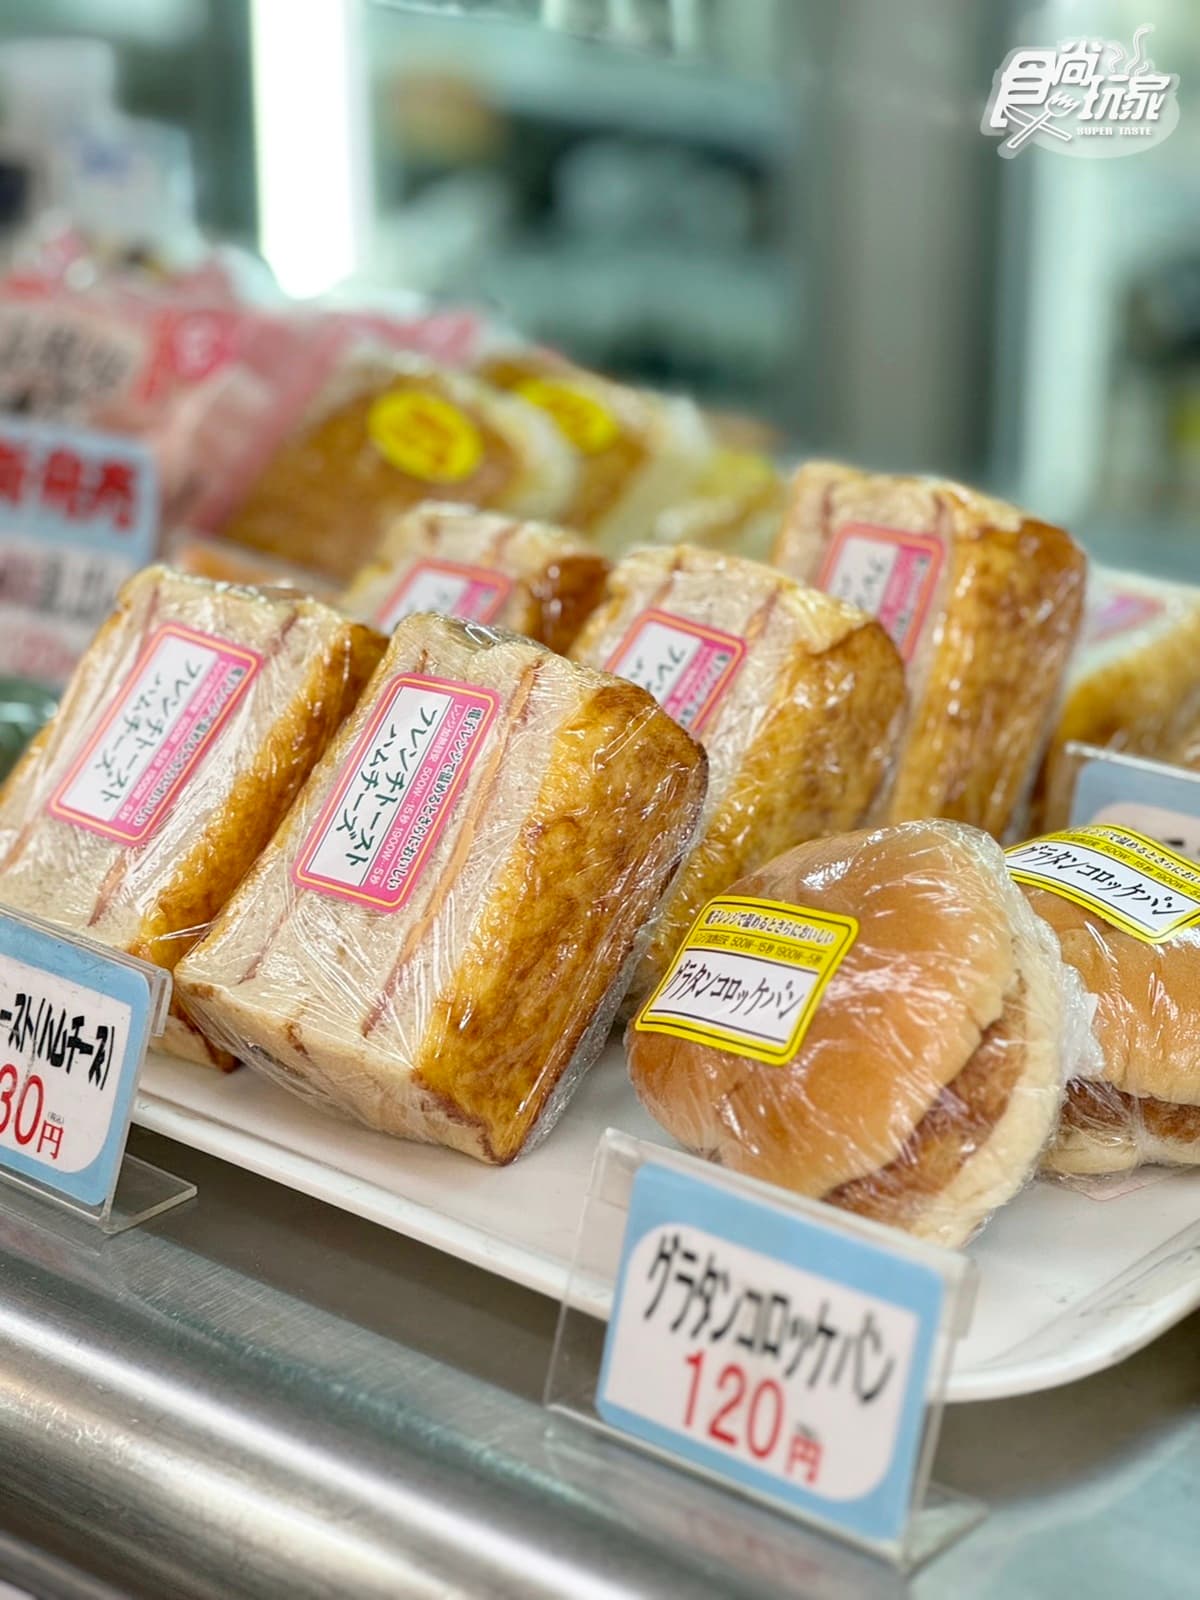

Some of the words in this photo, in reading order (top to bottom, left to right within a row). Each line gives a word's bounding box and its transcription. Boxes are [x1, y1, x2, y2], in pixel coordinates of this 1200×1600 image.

[95, 671, 161, 778] ハムチーズ
[100, 660, 202, 802] フレンチトースト
[335, 724, 397, 840] ハムチーズ
[345, 707, 438, 866] フレンチトースト
[388, 708, 482, 889] 電子レンジで温めるとさらにおいしい
[1006, 845, 1185, 915] グラタンコロッケパン
[660, 959, 804, 1020] グラタンコロッケパン
[643, 1233, 896, 1405] グラタンコロッケパン
